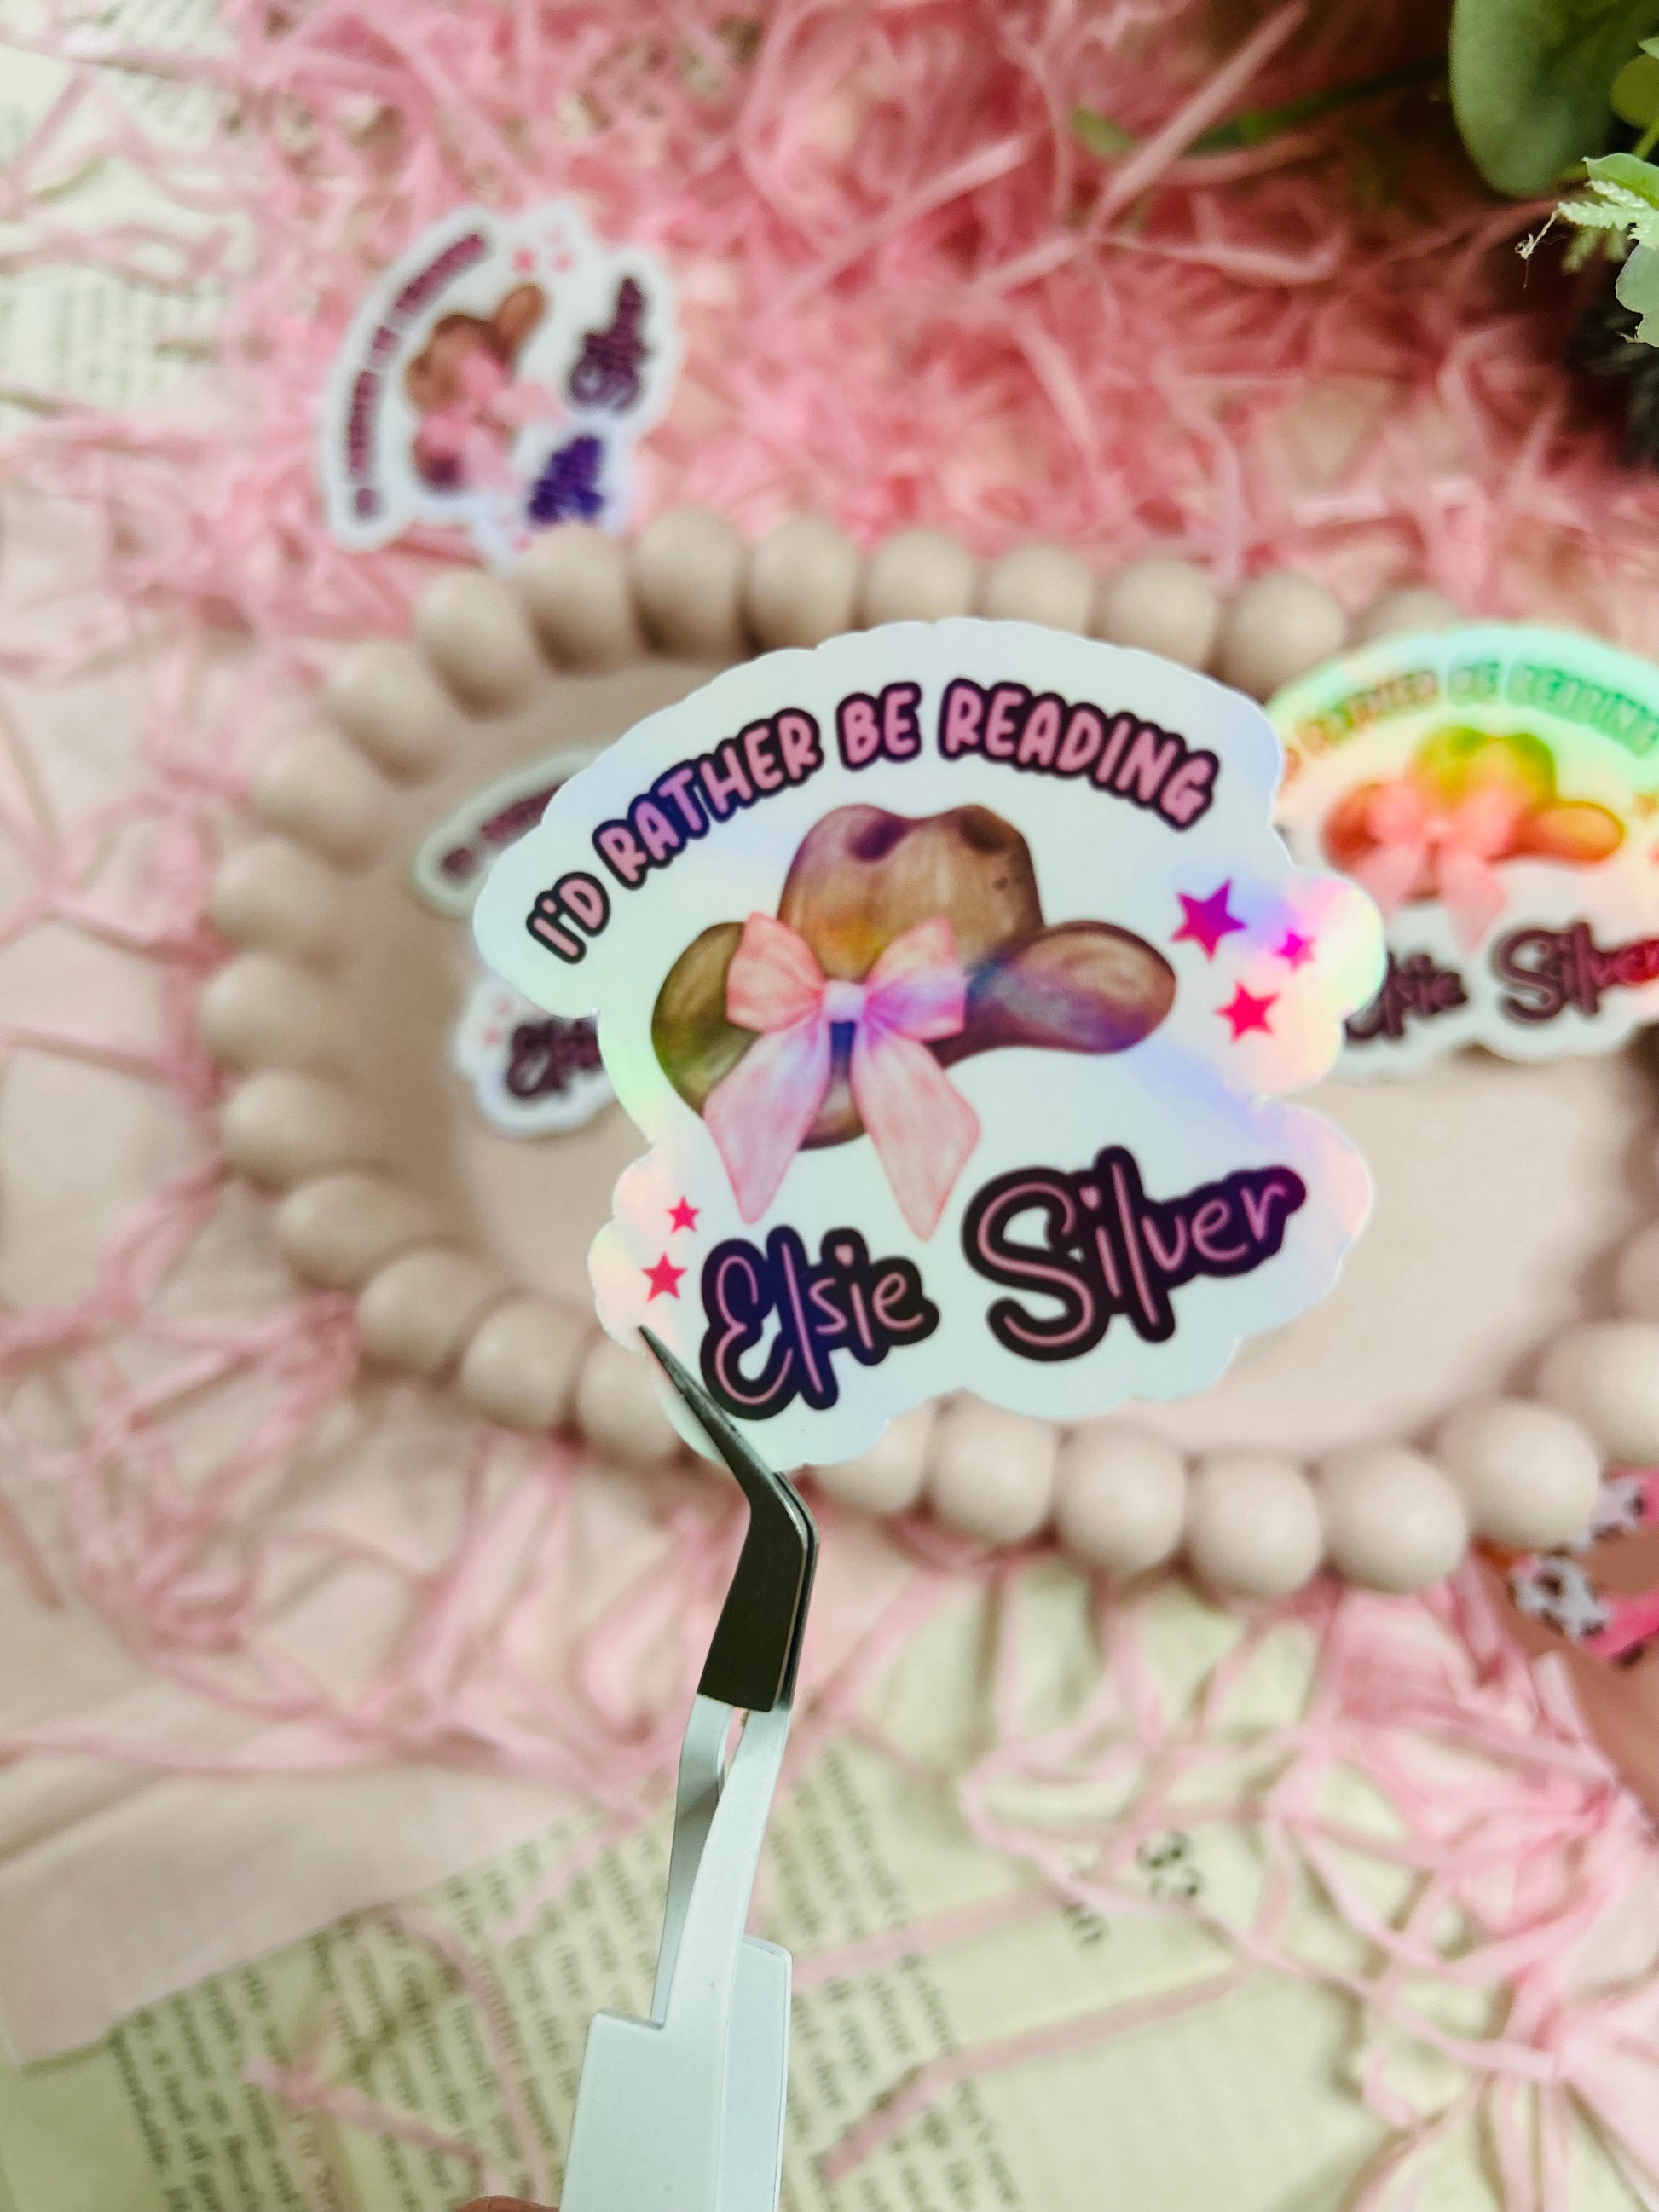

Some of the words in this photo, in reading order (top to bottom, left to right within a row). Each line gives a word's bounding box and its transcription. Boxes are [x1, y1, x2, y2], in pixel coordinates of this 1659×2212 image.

[527, 871, 611, 964] I'D
[592, 707, 824, 891] RATHER
[835, 681, 922, 772] BE
[939, 678, 1220, 831] READING
[699, 1225, 940, 1420] Elsie
[961, 1145, 1307, 1362] Silver
